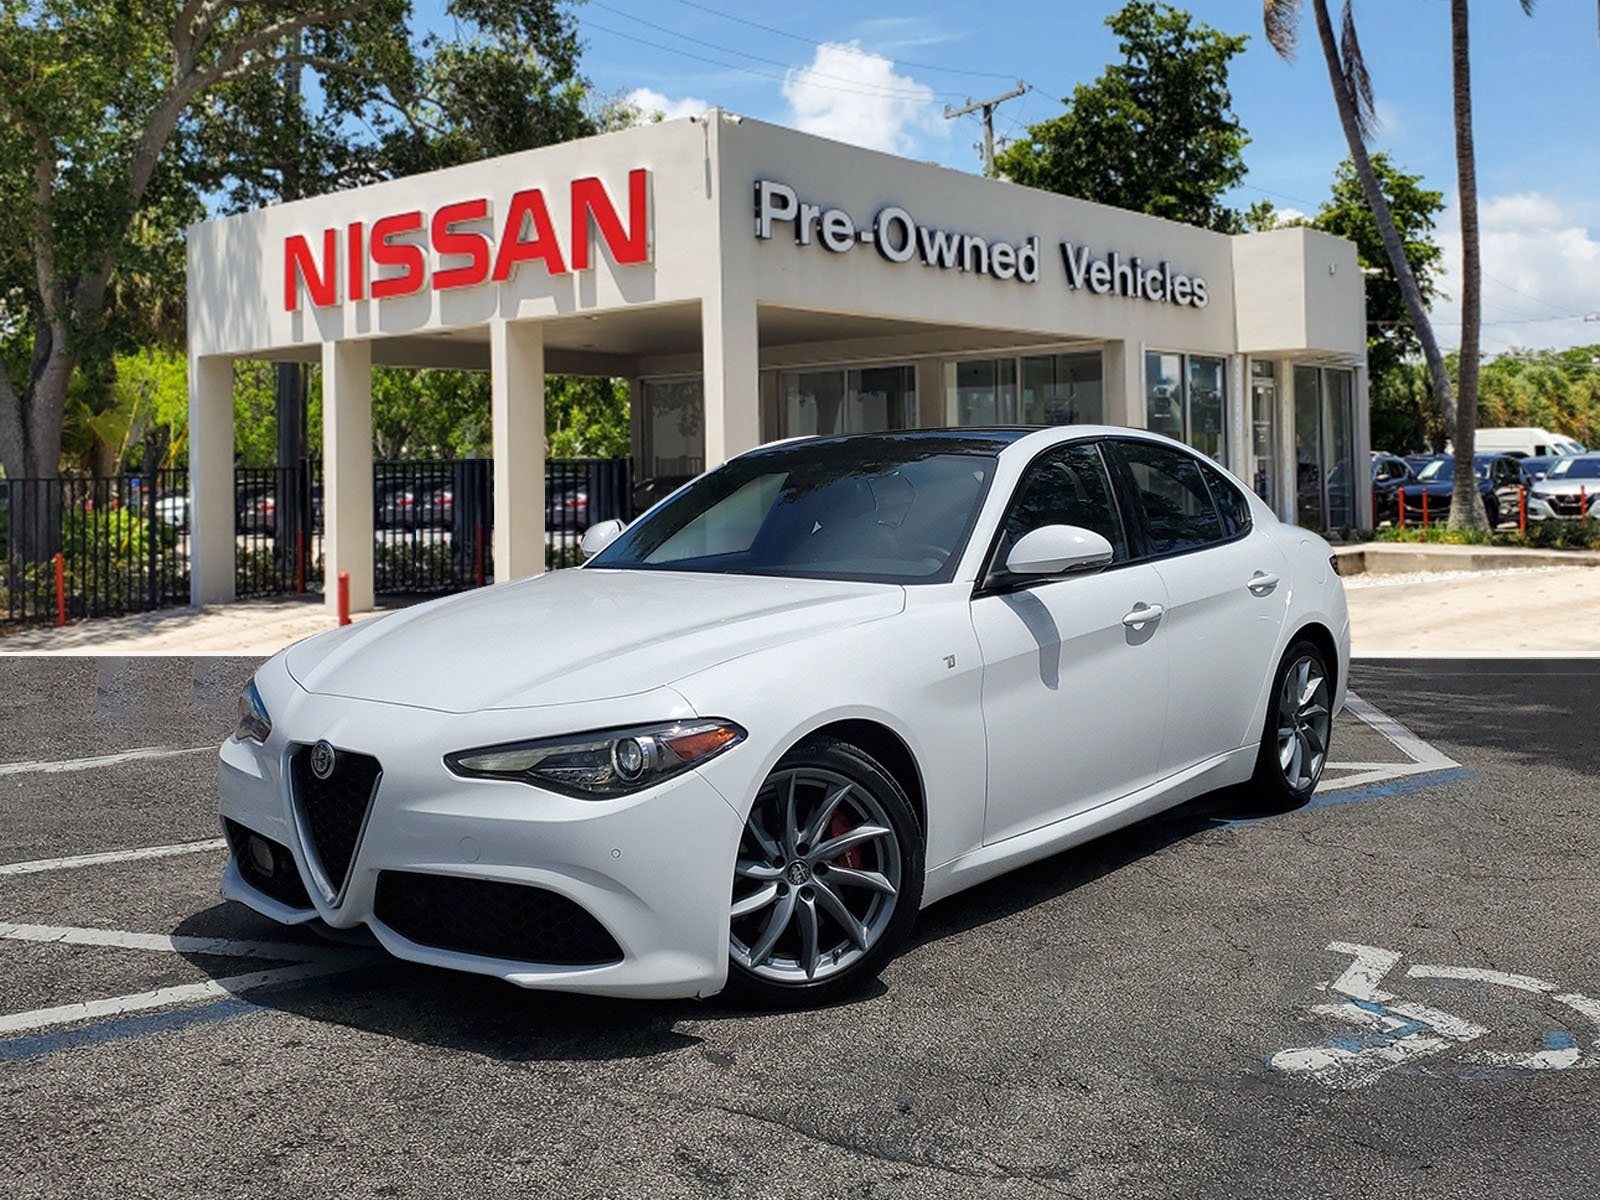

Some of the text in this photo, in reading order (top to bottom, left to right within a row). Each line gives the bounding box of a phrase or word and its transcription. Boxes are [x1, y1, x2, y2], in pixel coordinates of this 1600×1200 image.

[284, 168, 648, 312] NISSAN
[754, 179, 1208, 308] Pre-Owned Vehicles
